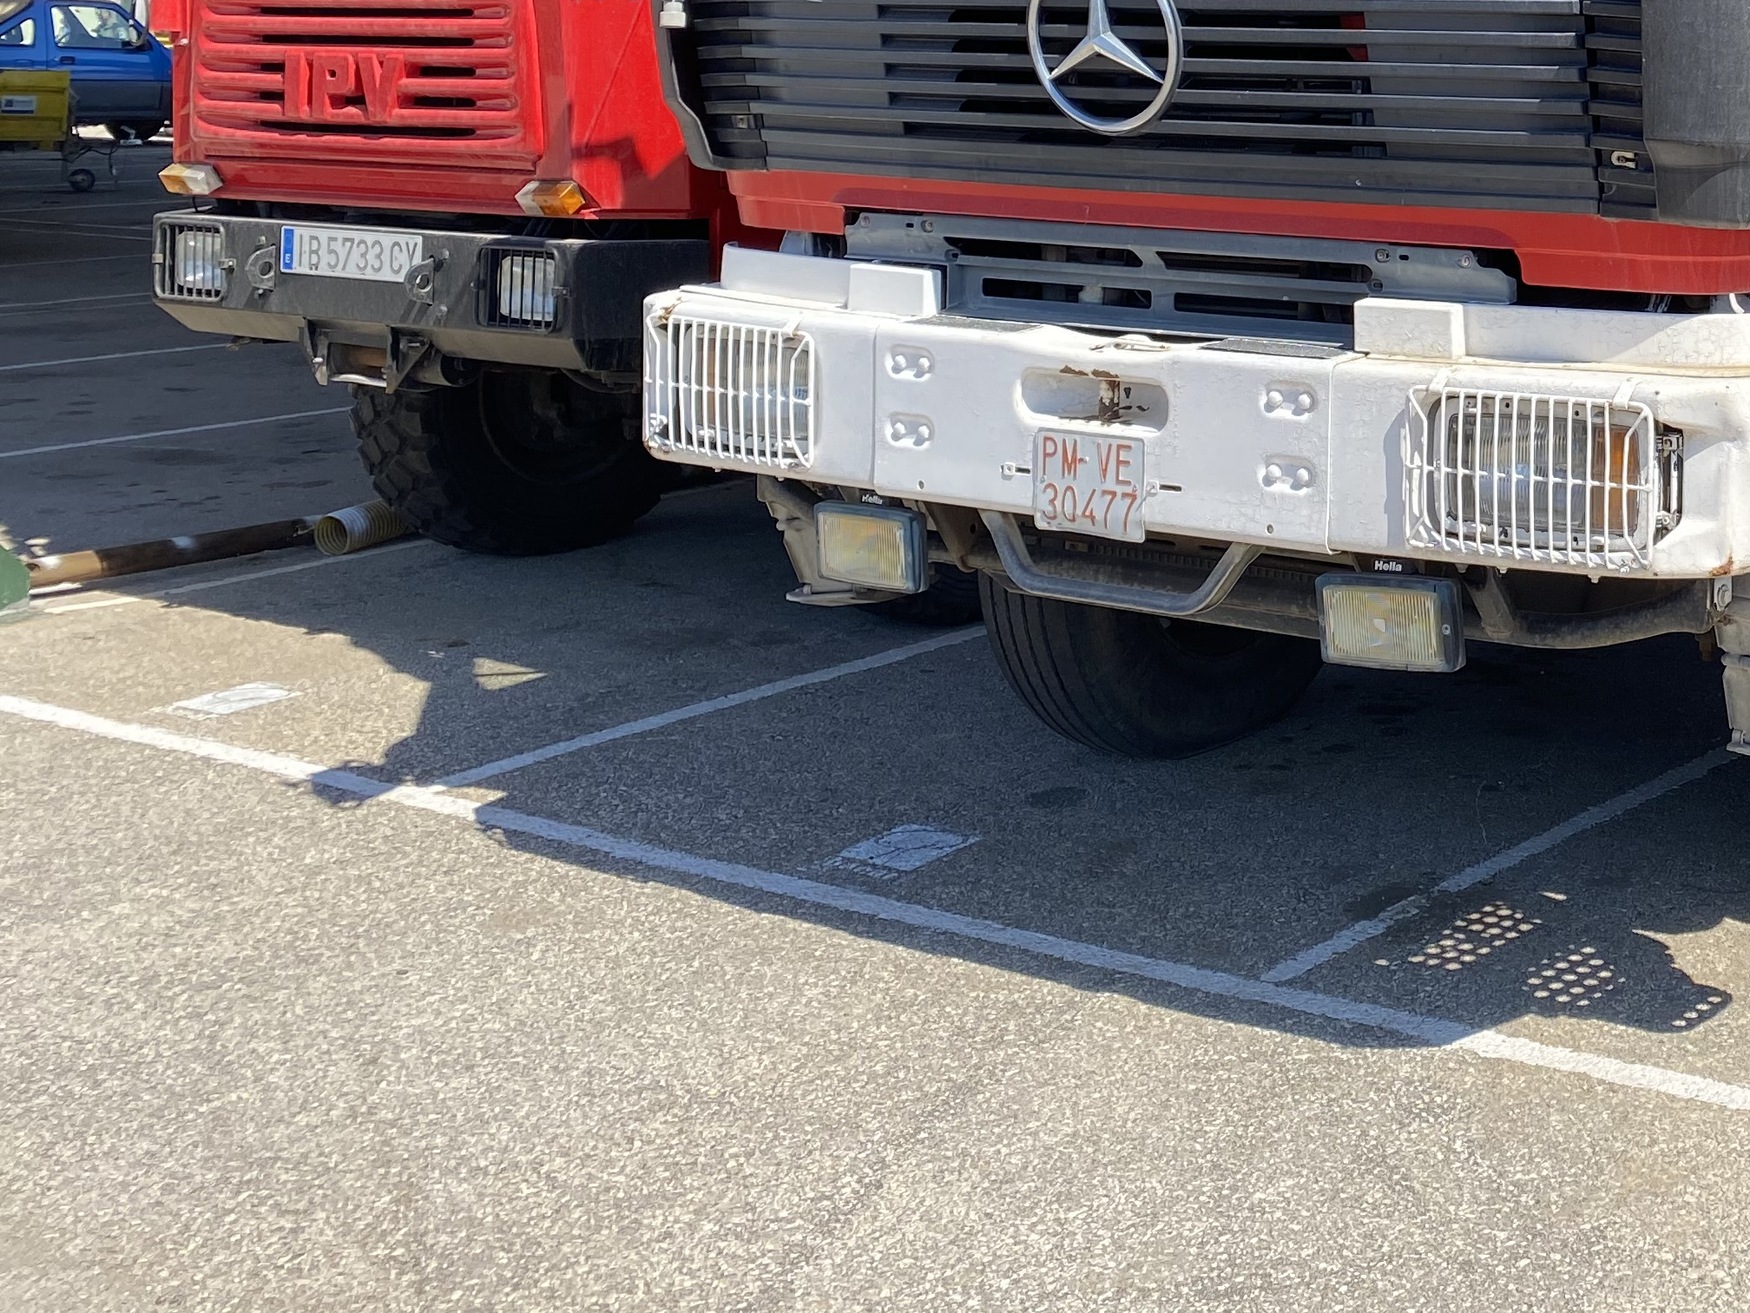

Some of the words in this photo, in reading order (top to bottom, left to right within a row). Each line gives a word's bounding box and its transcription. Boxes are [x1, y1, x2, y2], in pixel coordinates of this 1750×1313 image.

[283, 50, 404, 122] IPV
[327, 236, 384, 274] 5733
[1097, 441, 1133, 486] VE
[1042, 482, 1138, 534] 30477
[1374, 560, 1403, 572] Hella
